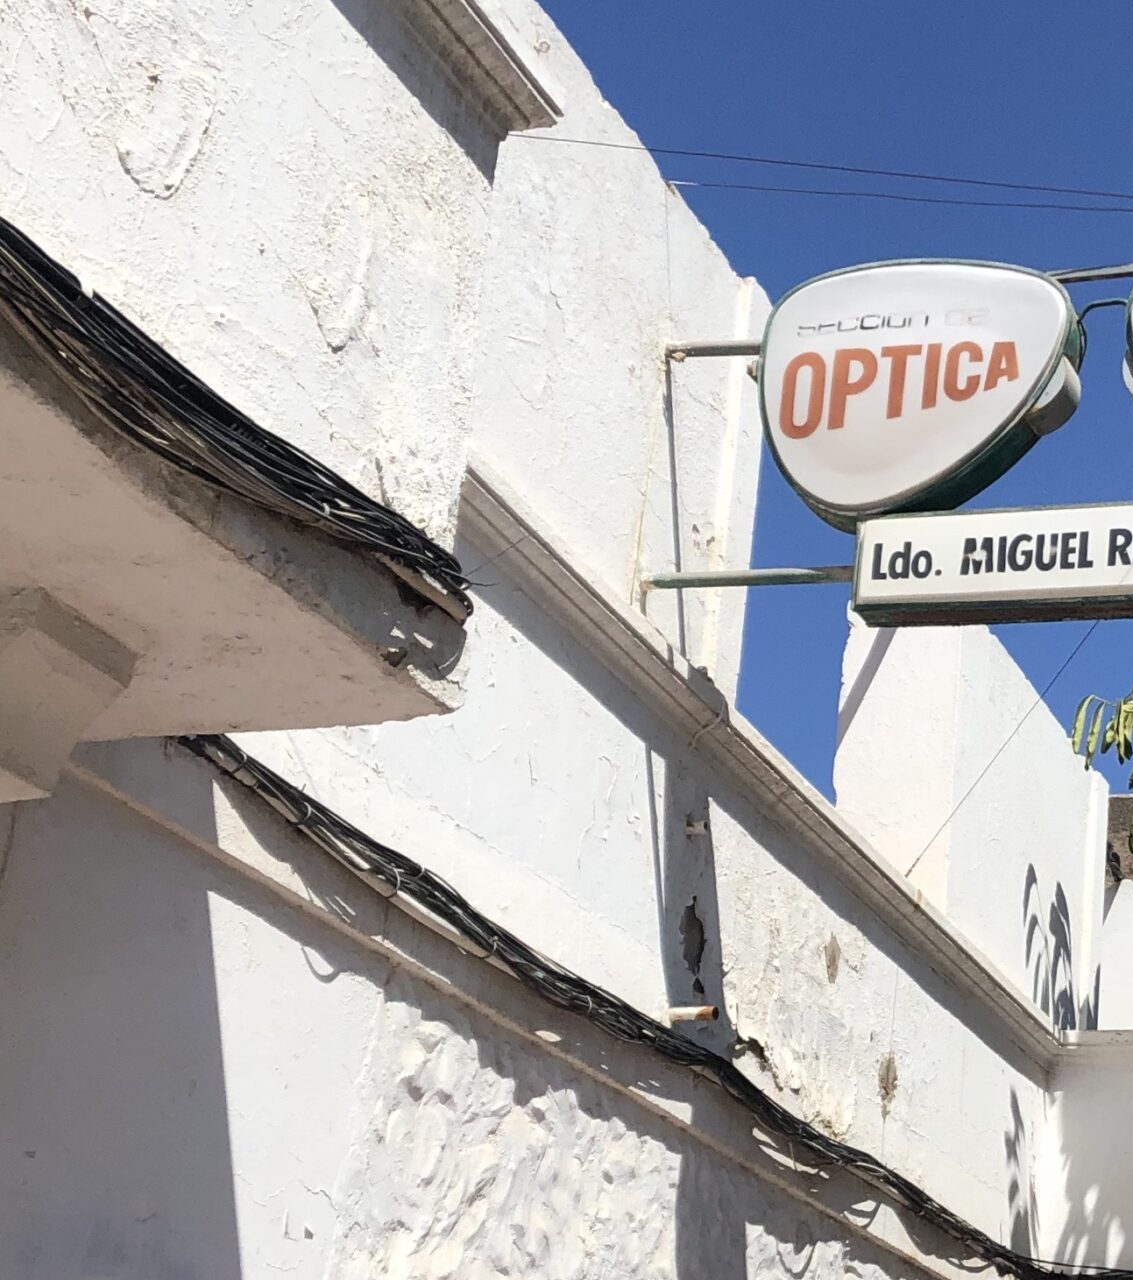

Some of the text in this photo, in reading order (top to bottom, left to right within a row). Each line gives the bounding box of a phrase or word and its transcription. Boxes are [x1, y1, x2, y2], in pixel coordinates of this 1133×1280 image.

[779, 340, 1020, 440] OPTICA
[870, 542, 943, 581] Ldo.
[959, 531, 1094, 576] MIGUEL
